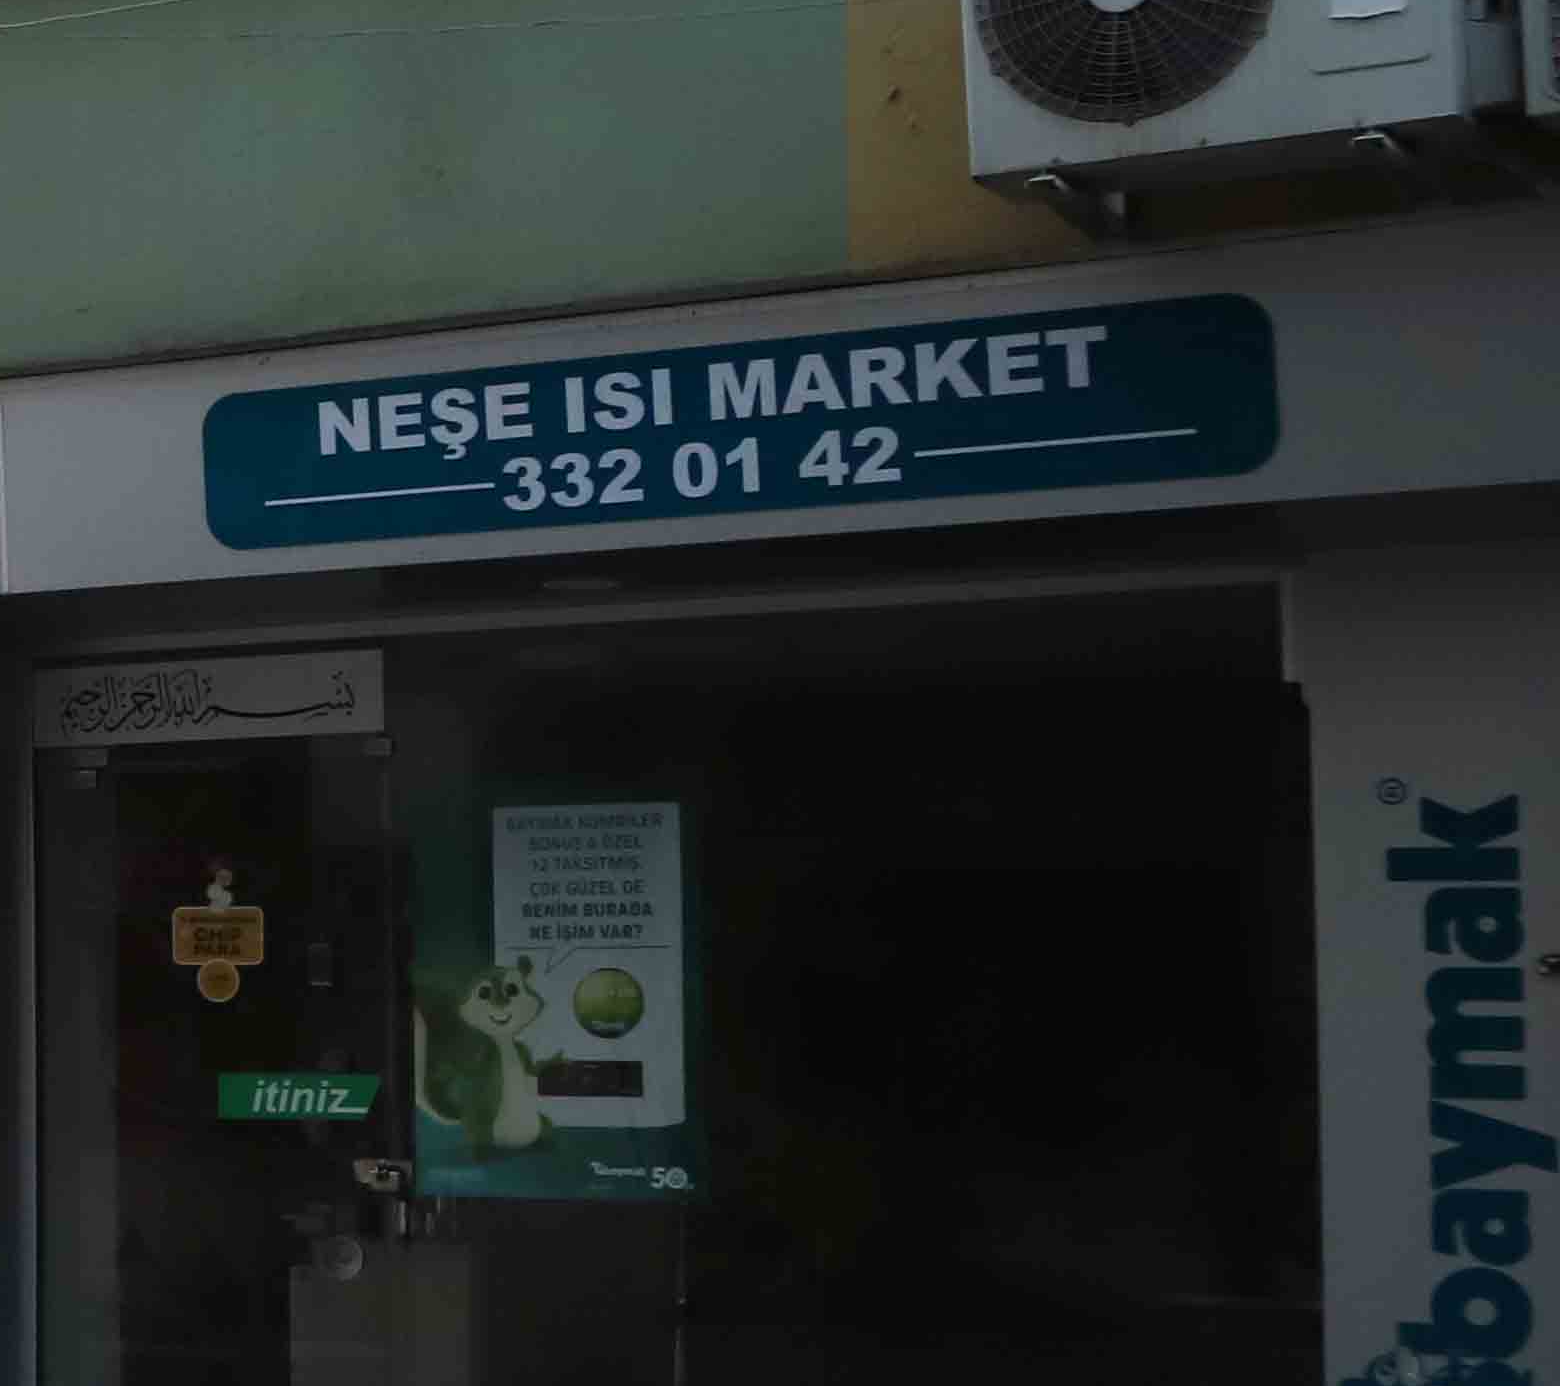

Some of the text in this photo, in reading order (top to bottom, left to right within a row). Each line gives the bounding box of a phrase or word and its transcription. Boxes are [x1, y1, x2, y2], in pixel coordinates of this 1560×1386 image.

[318, 325, 1108, 460] NEŞE ISI MARKET
[502, 426, 902, 512] 332 01 42
[251, 1079, 356, 1115] itiniz
[1385, 793, 1558, 1363] baymak
